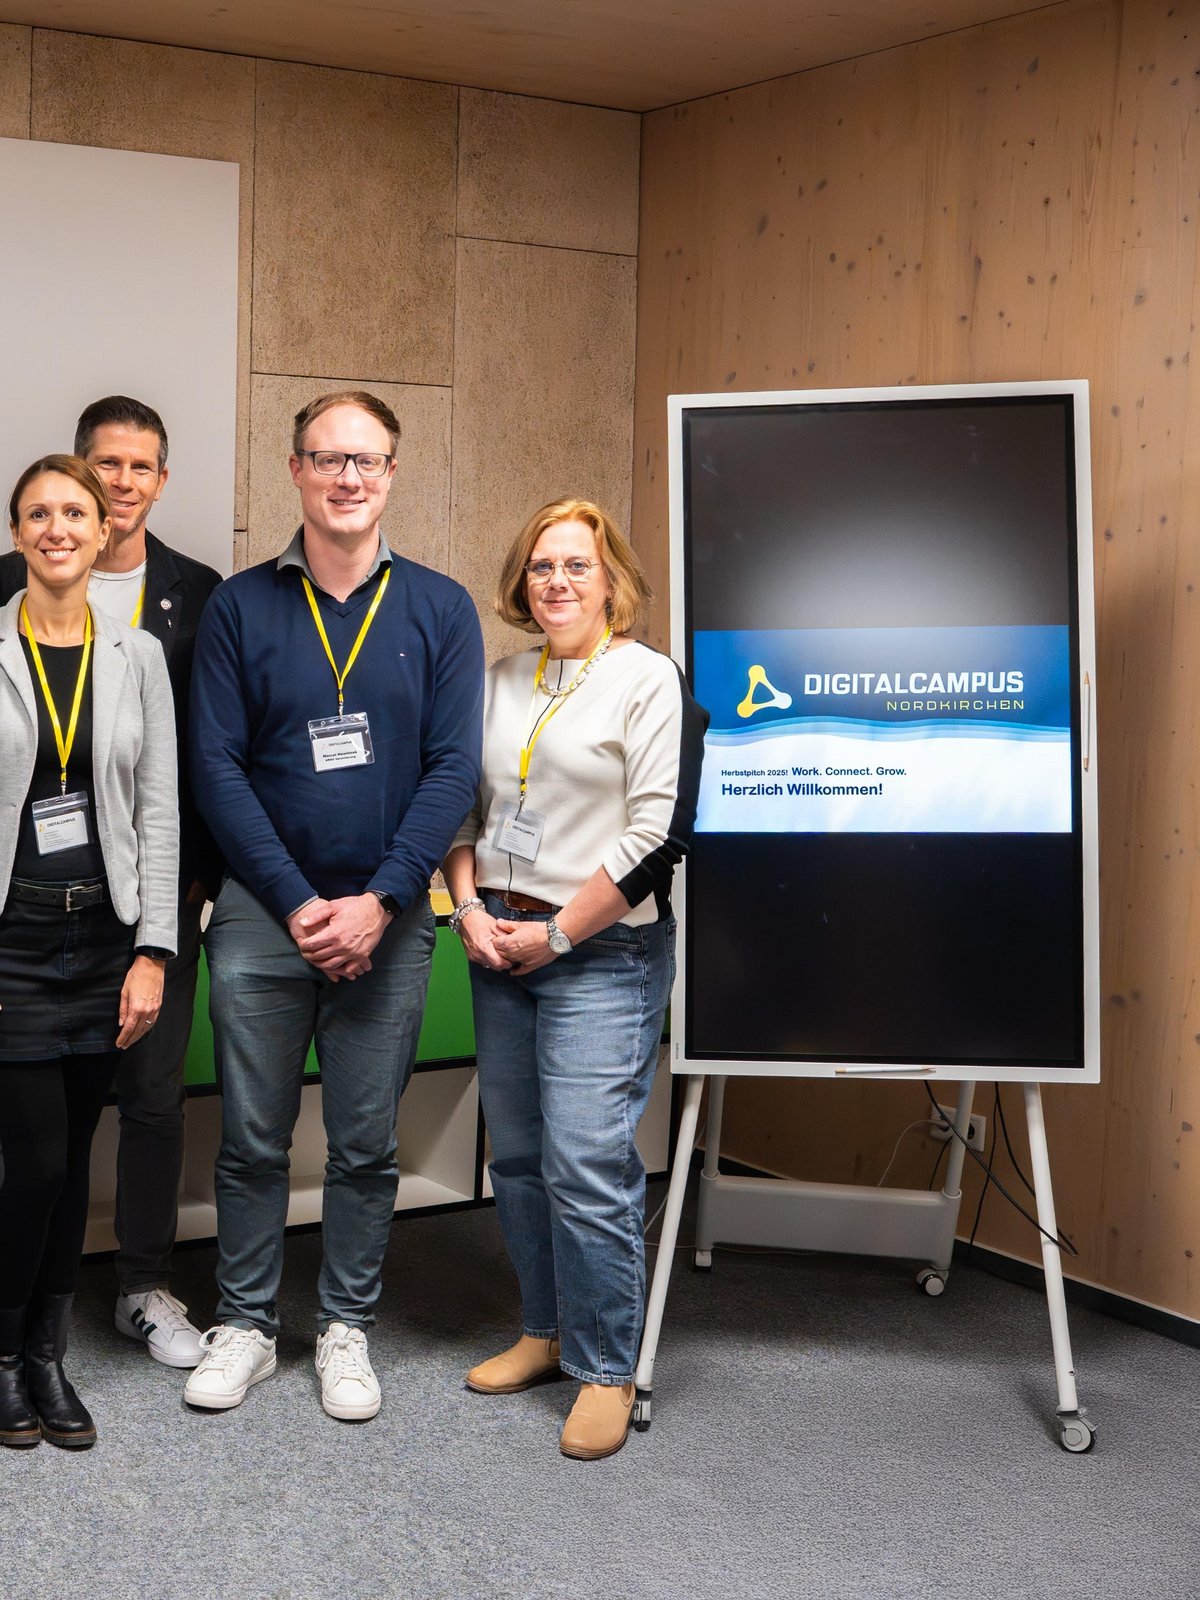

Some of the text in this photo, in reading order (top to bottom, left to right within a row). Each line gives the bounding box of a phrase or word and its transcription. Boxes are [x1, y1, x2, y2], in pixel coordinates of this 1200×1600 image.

[803, 671, 1025, 696] DIGITALCAMPUS
[886, 700, 1025, 711] NORDKIRCHEN
[721, 769, 766, 778] Herbstpitch
[791, 766, 822, 776] Work.
[825, 766, 873, 776] Connect.
[876, 766, 907, 776] Grow.
[721, 783, 884, 796] Herzlich Willkommen!
